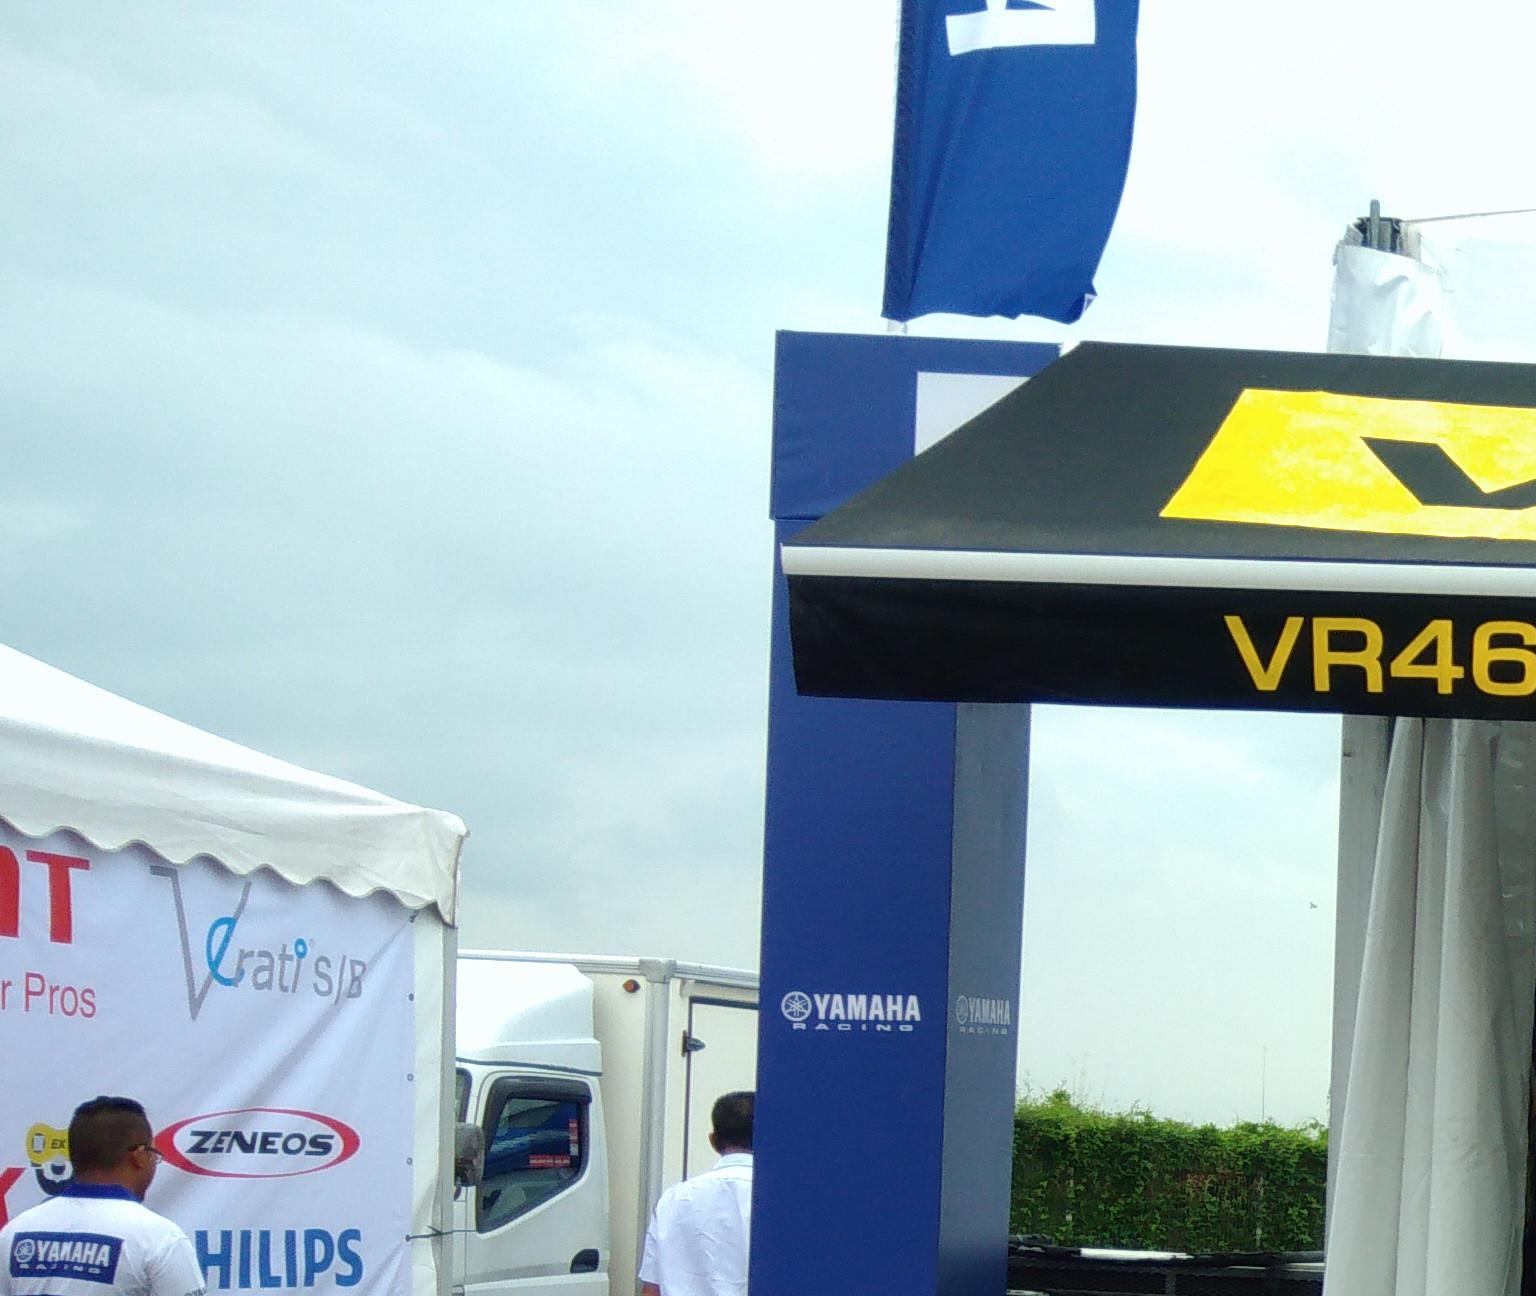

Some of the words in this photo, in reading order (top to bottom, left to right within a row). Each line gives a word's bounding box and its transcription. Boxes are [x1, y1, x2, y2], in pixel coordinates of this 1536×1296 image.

[25, 971, 97, 1019] Pros
[813, 993, 921, 1022] YAMAHA
[968, 996, 1011, 1026] YAMAHA
[793, 1022, 914, 1032] RACING
[185, 1130, 335, 1157] ZENEOS
[37, 1238, 111, 1267] YAMAHA
[194, 1227, 364, 1289] HILIPS
